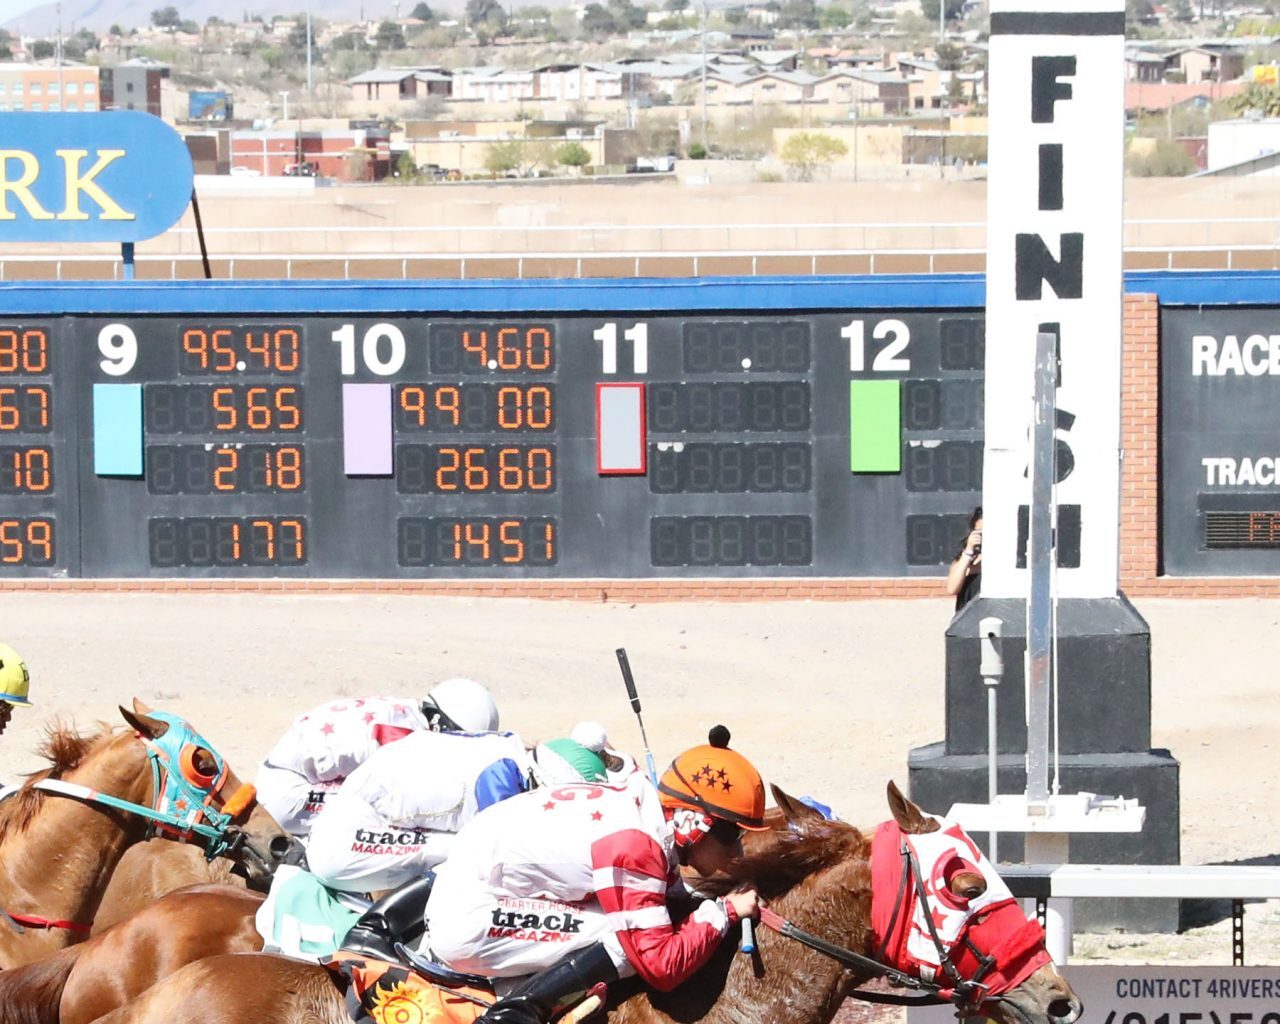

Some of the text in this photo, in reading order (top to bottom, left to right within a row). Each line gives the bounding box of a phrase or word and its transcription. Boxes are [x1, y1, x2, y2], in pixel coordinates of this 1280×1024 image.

[98, 324, 137, 375] 9
[184, 330, 298, 370] 95.40
[332, 324, 405, 375] 10
[463, 329, 550, 369] 4.60
[594, 323, 648, 373] 11
[841, 320, 910, 371] 12
[213, 388, 299, 429] 565
[215, 448, 300, 489] 218
[437, 449, 551, 489] 2660
[1202, 458, 1280, 486] TRAC
[233, 521, 301, 558] 177
[455, 522, 552, 562] 1451
[355, 826, 430, 845] track
[491, 908, 584, 933] track
[1116, 978, 1203, 998] CONTACT
